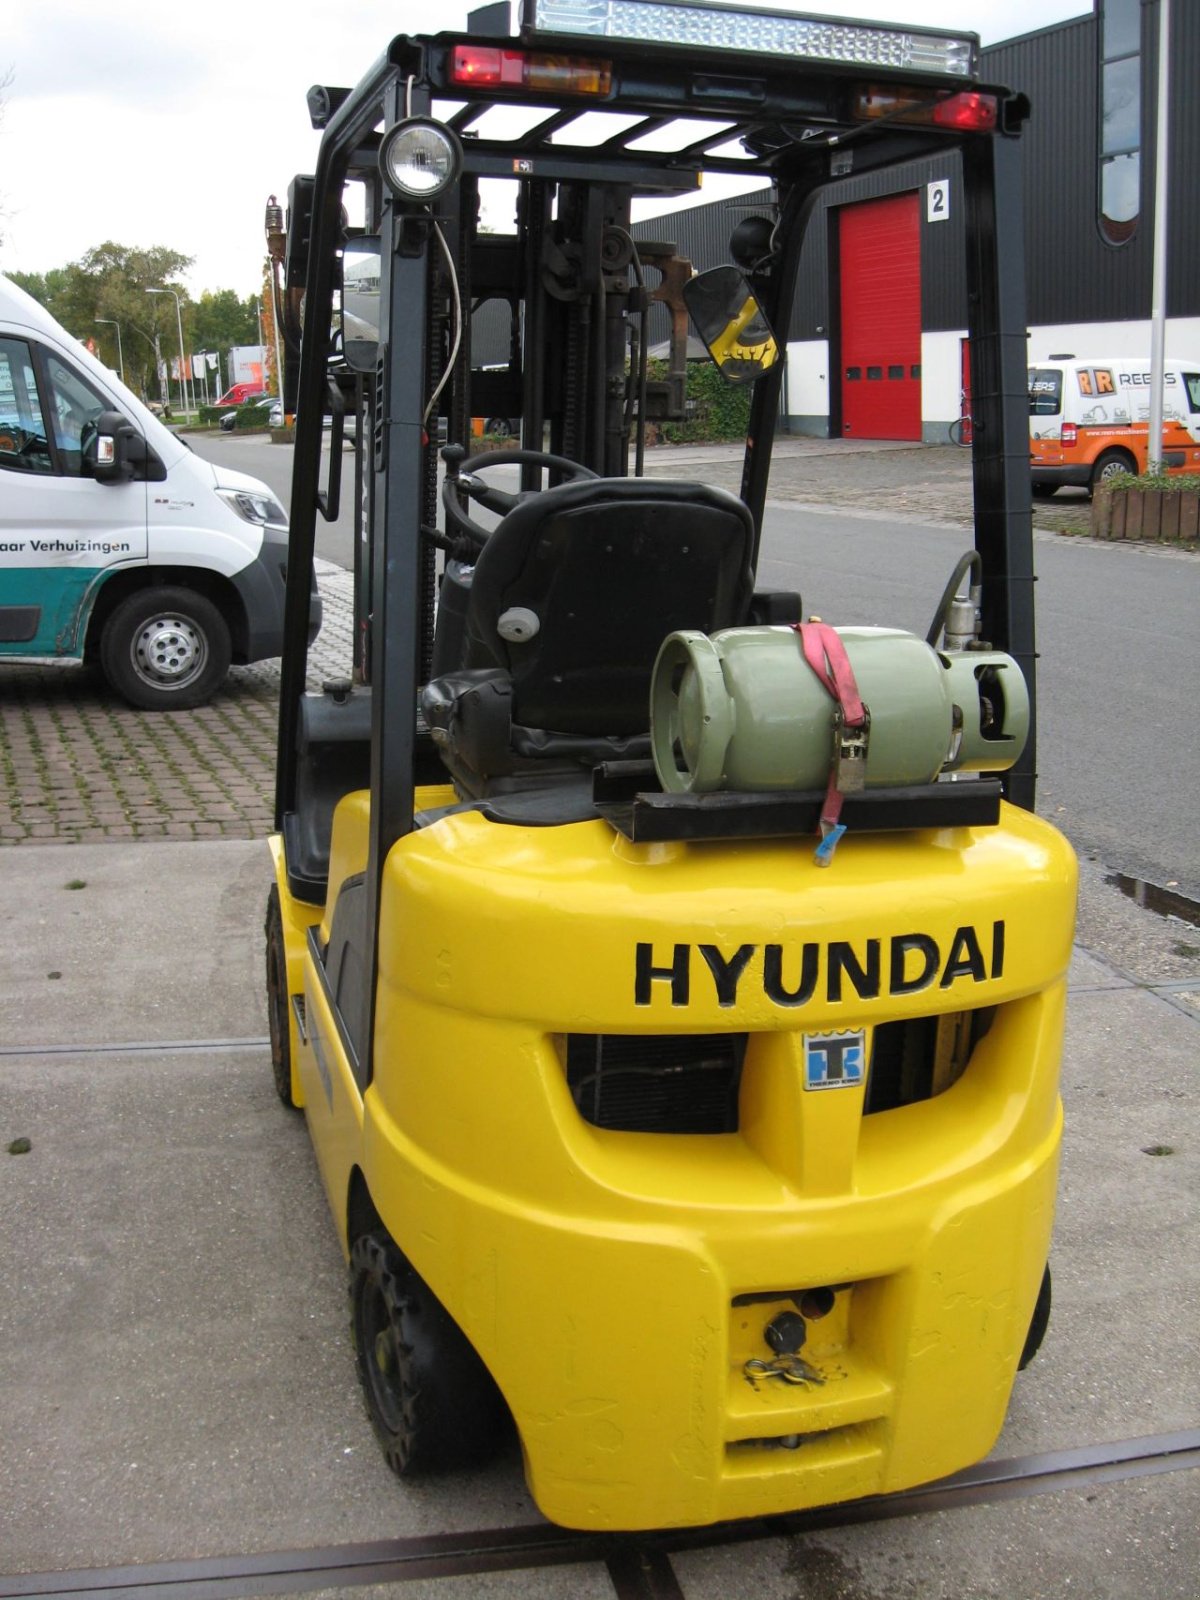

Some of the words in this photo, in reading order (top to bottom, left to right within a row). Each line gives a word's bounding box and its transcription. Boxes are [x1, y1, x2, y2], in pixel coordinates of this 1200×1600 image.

[933, 188, 944, 213] 2
[1119, 373, 1176, 385] REES
[30, 540, 130, 554] Verhuizingen
[634, 920, 1005, 1008] HYUNDAI
